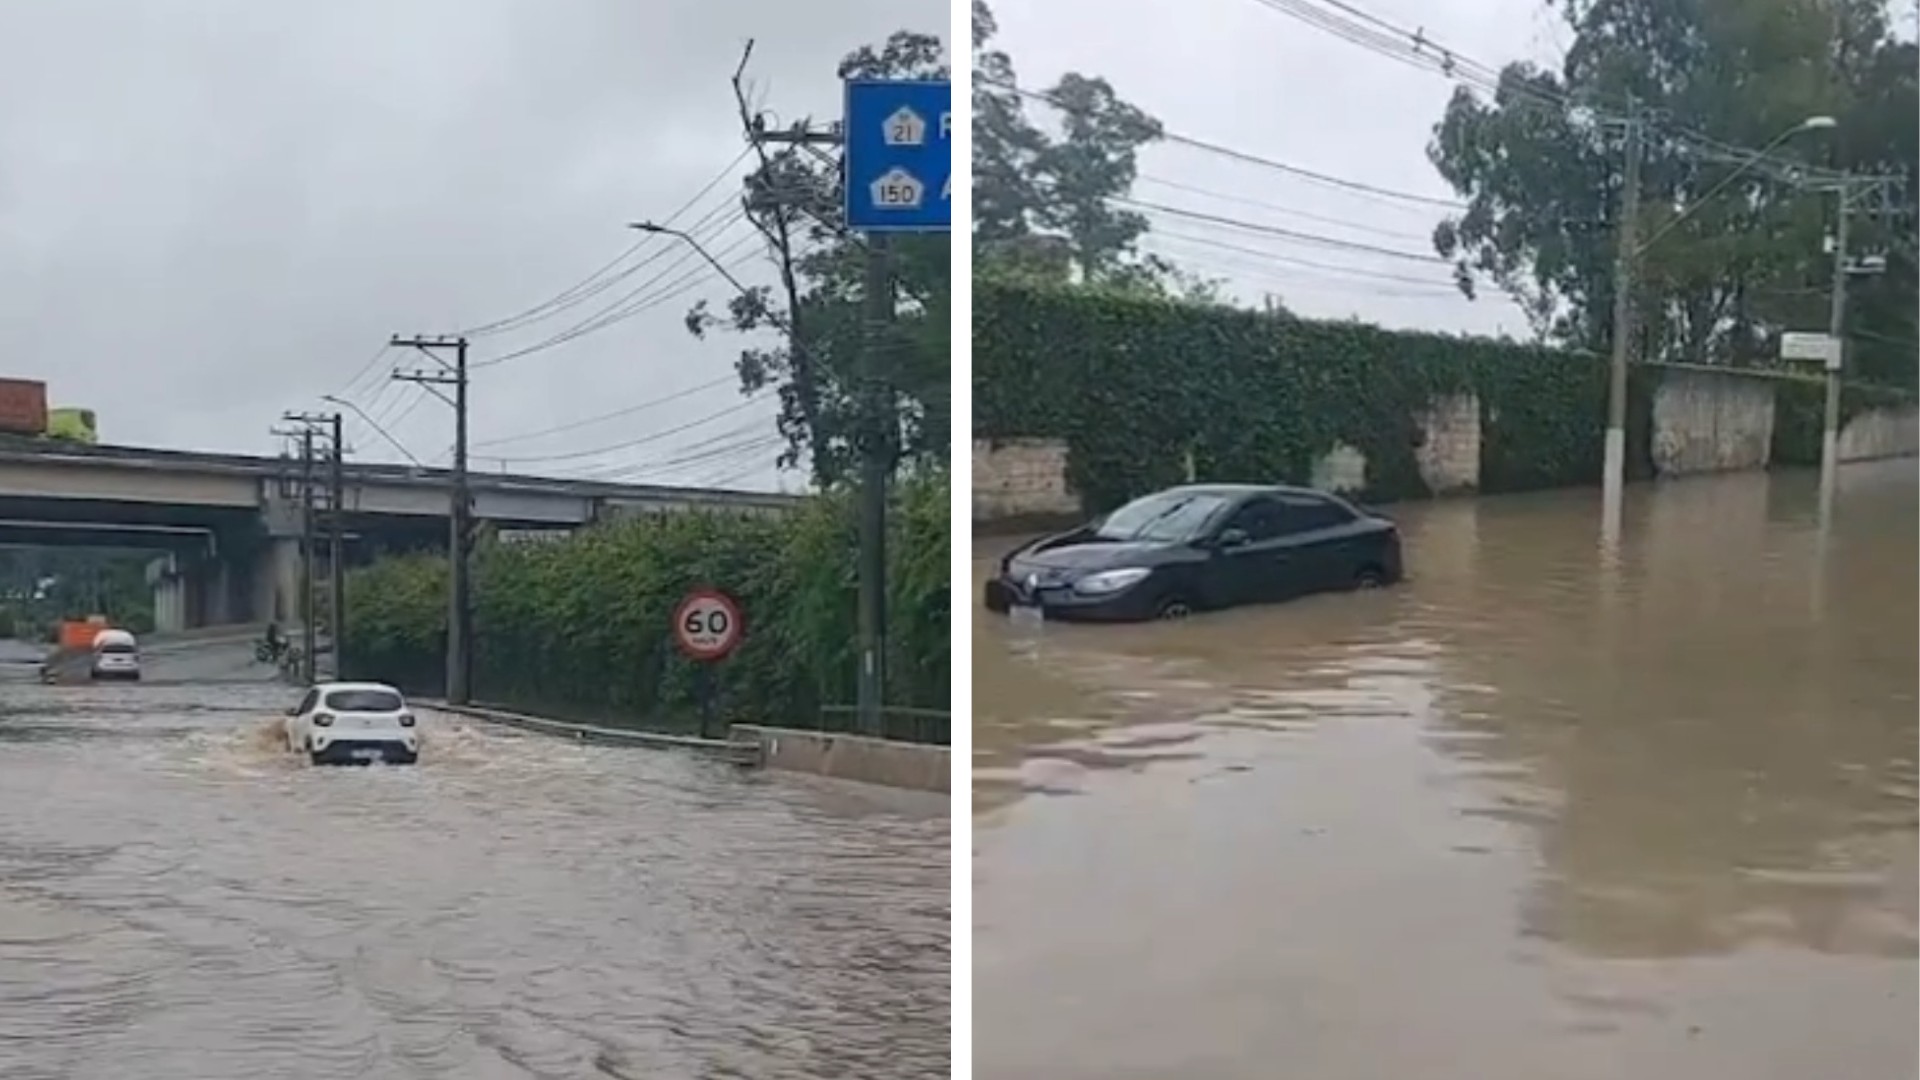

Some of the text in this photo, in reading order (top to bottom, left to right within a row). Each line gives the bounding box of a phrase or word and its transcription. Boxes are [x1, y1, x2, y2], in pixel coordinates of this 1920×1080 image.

[893, 125, 911, 142] 21
[880, 185, 915, 203] 150
[685, 610, 727, 633] 60
